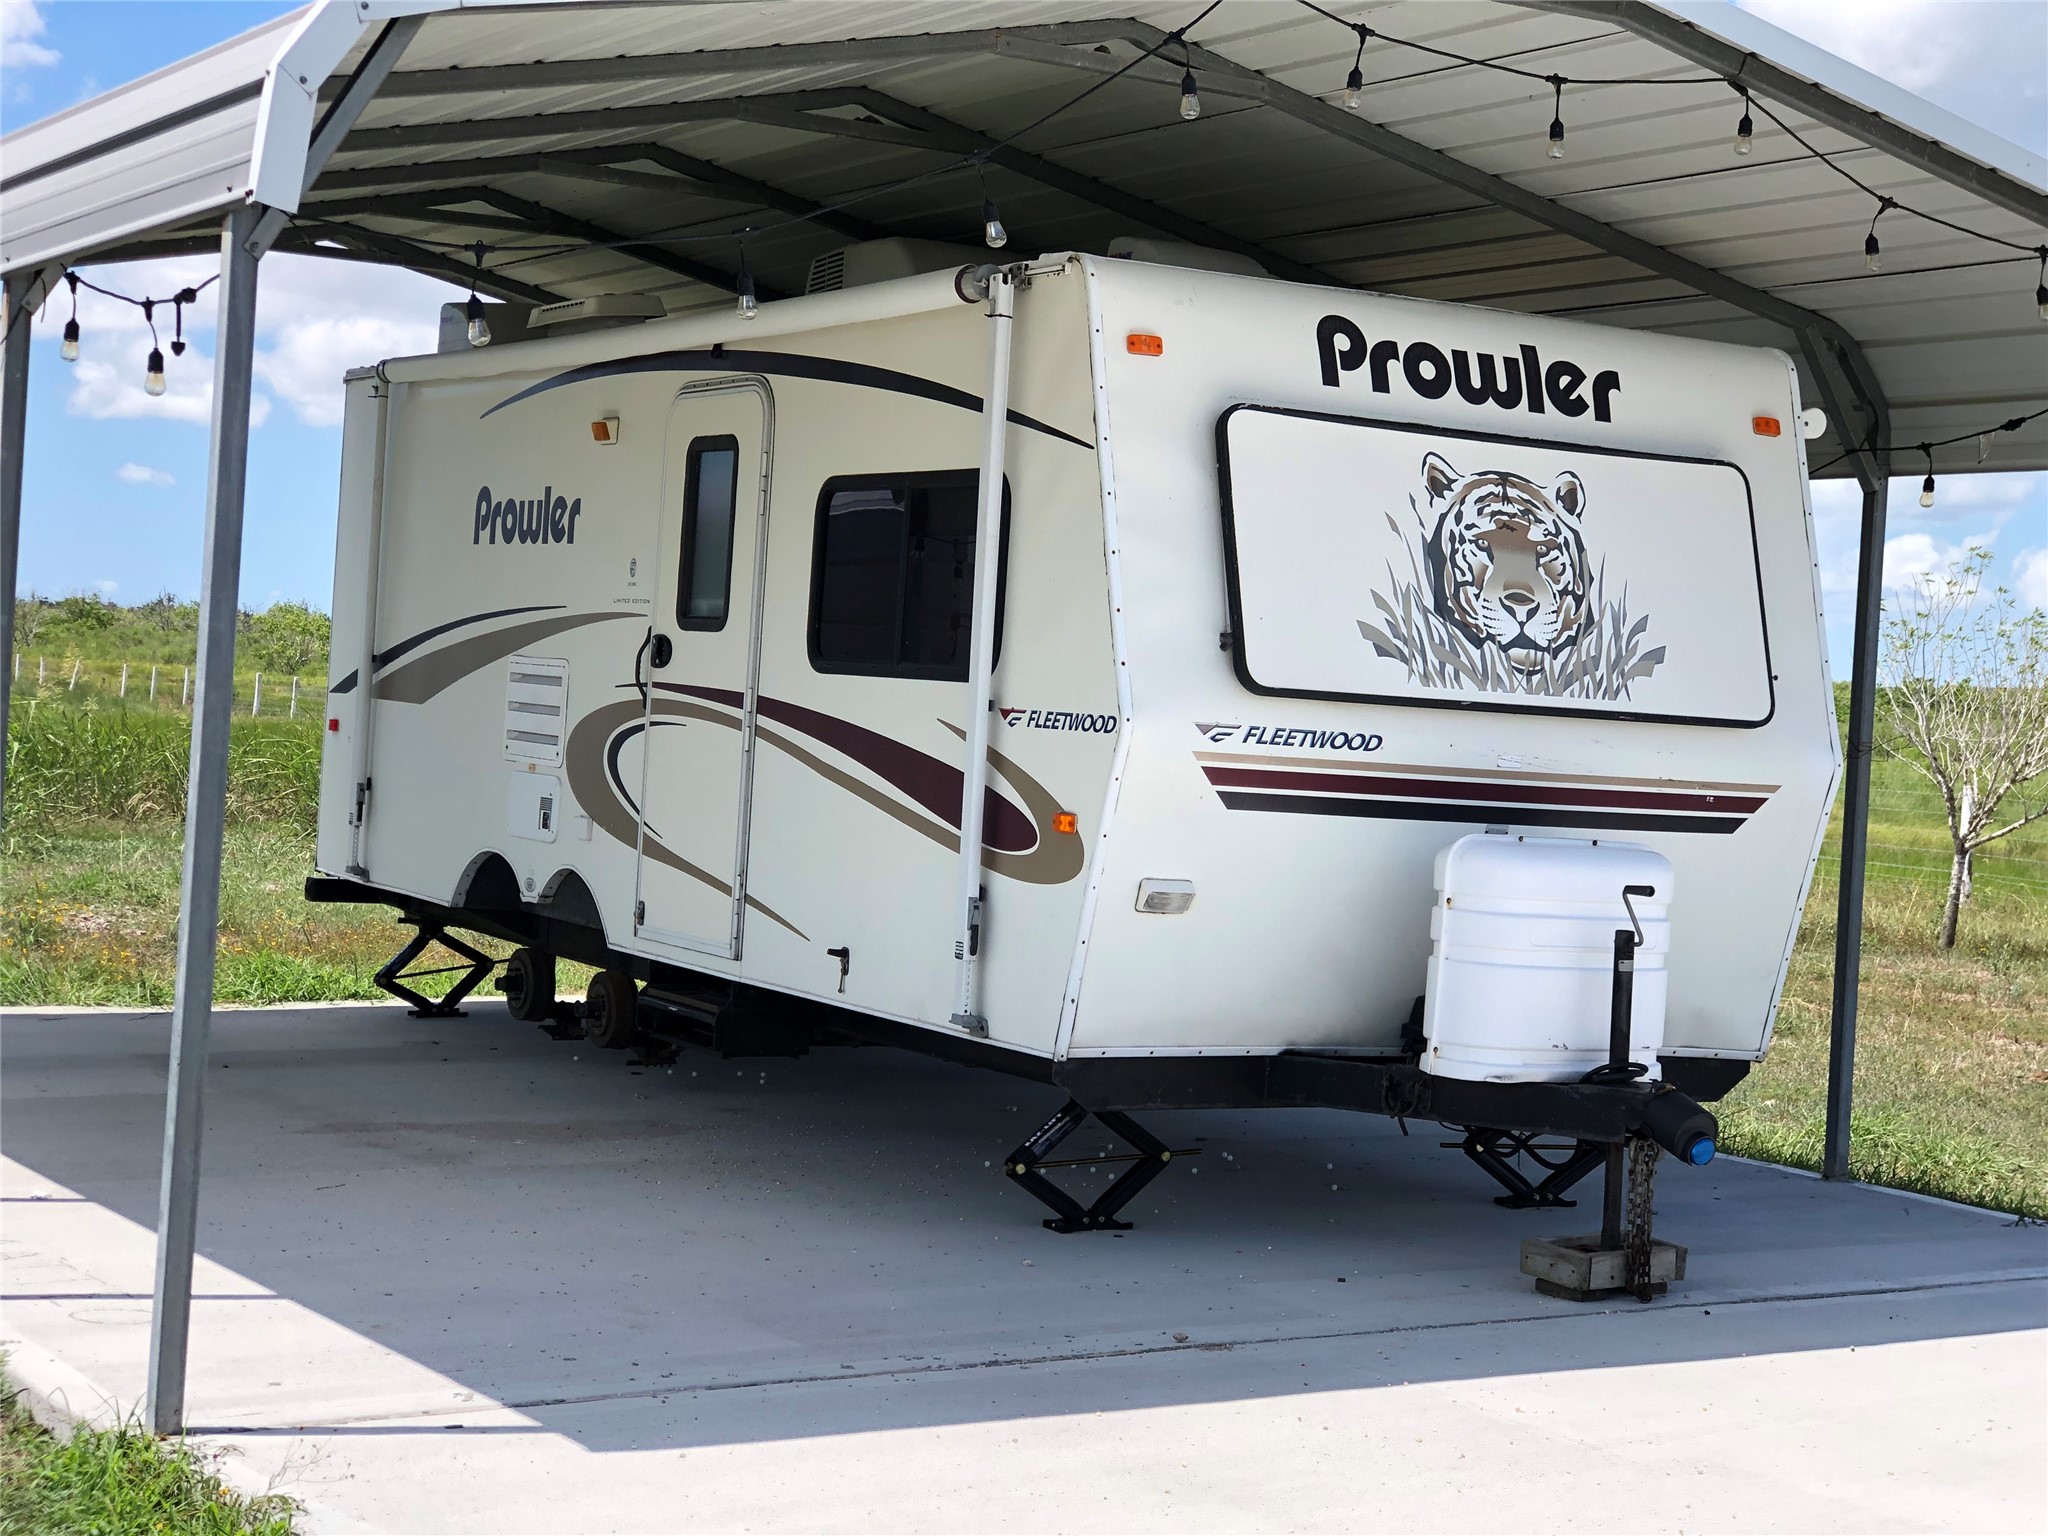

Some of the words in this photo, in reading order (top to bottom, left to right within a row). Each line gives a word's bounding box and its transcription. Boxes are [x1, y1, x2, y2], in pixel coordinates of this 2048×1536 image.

[1316, 314, 1621, 423] Prowler
[473, 485, 582, 545] Prowler
[1026, 709, 1117, 734] FLEETWOOD
[1241, 725, 1383, 752] FLEETWOOD
